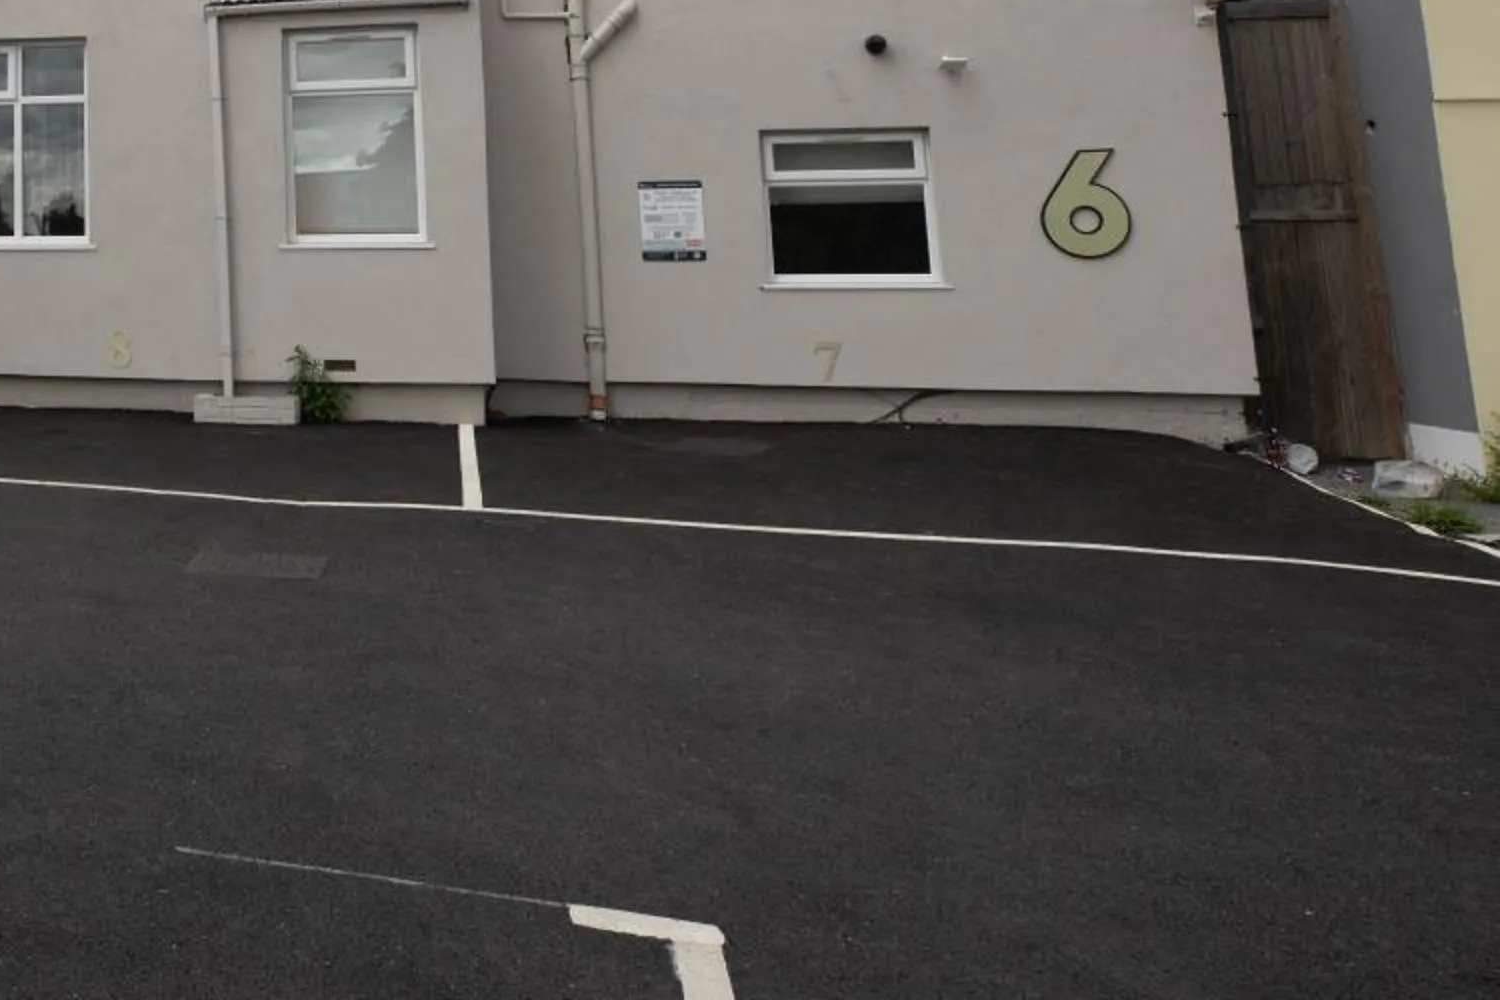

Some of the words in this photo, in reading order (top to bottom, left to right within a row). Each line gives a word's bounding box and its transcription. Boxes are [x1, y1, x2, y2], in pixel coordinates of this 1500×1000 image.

[1040, 148, 1131, 259] 6
[106, 328, 133, 370] 8
[811, 341, 842, 382] 7
